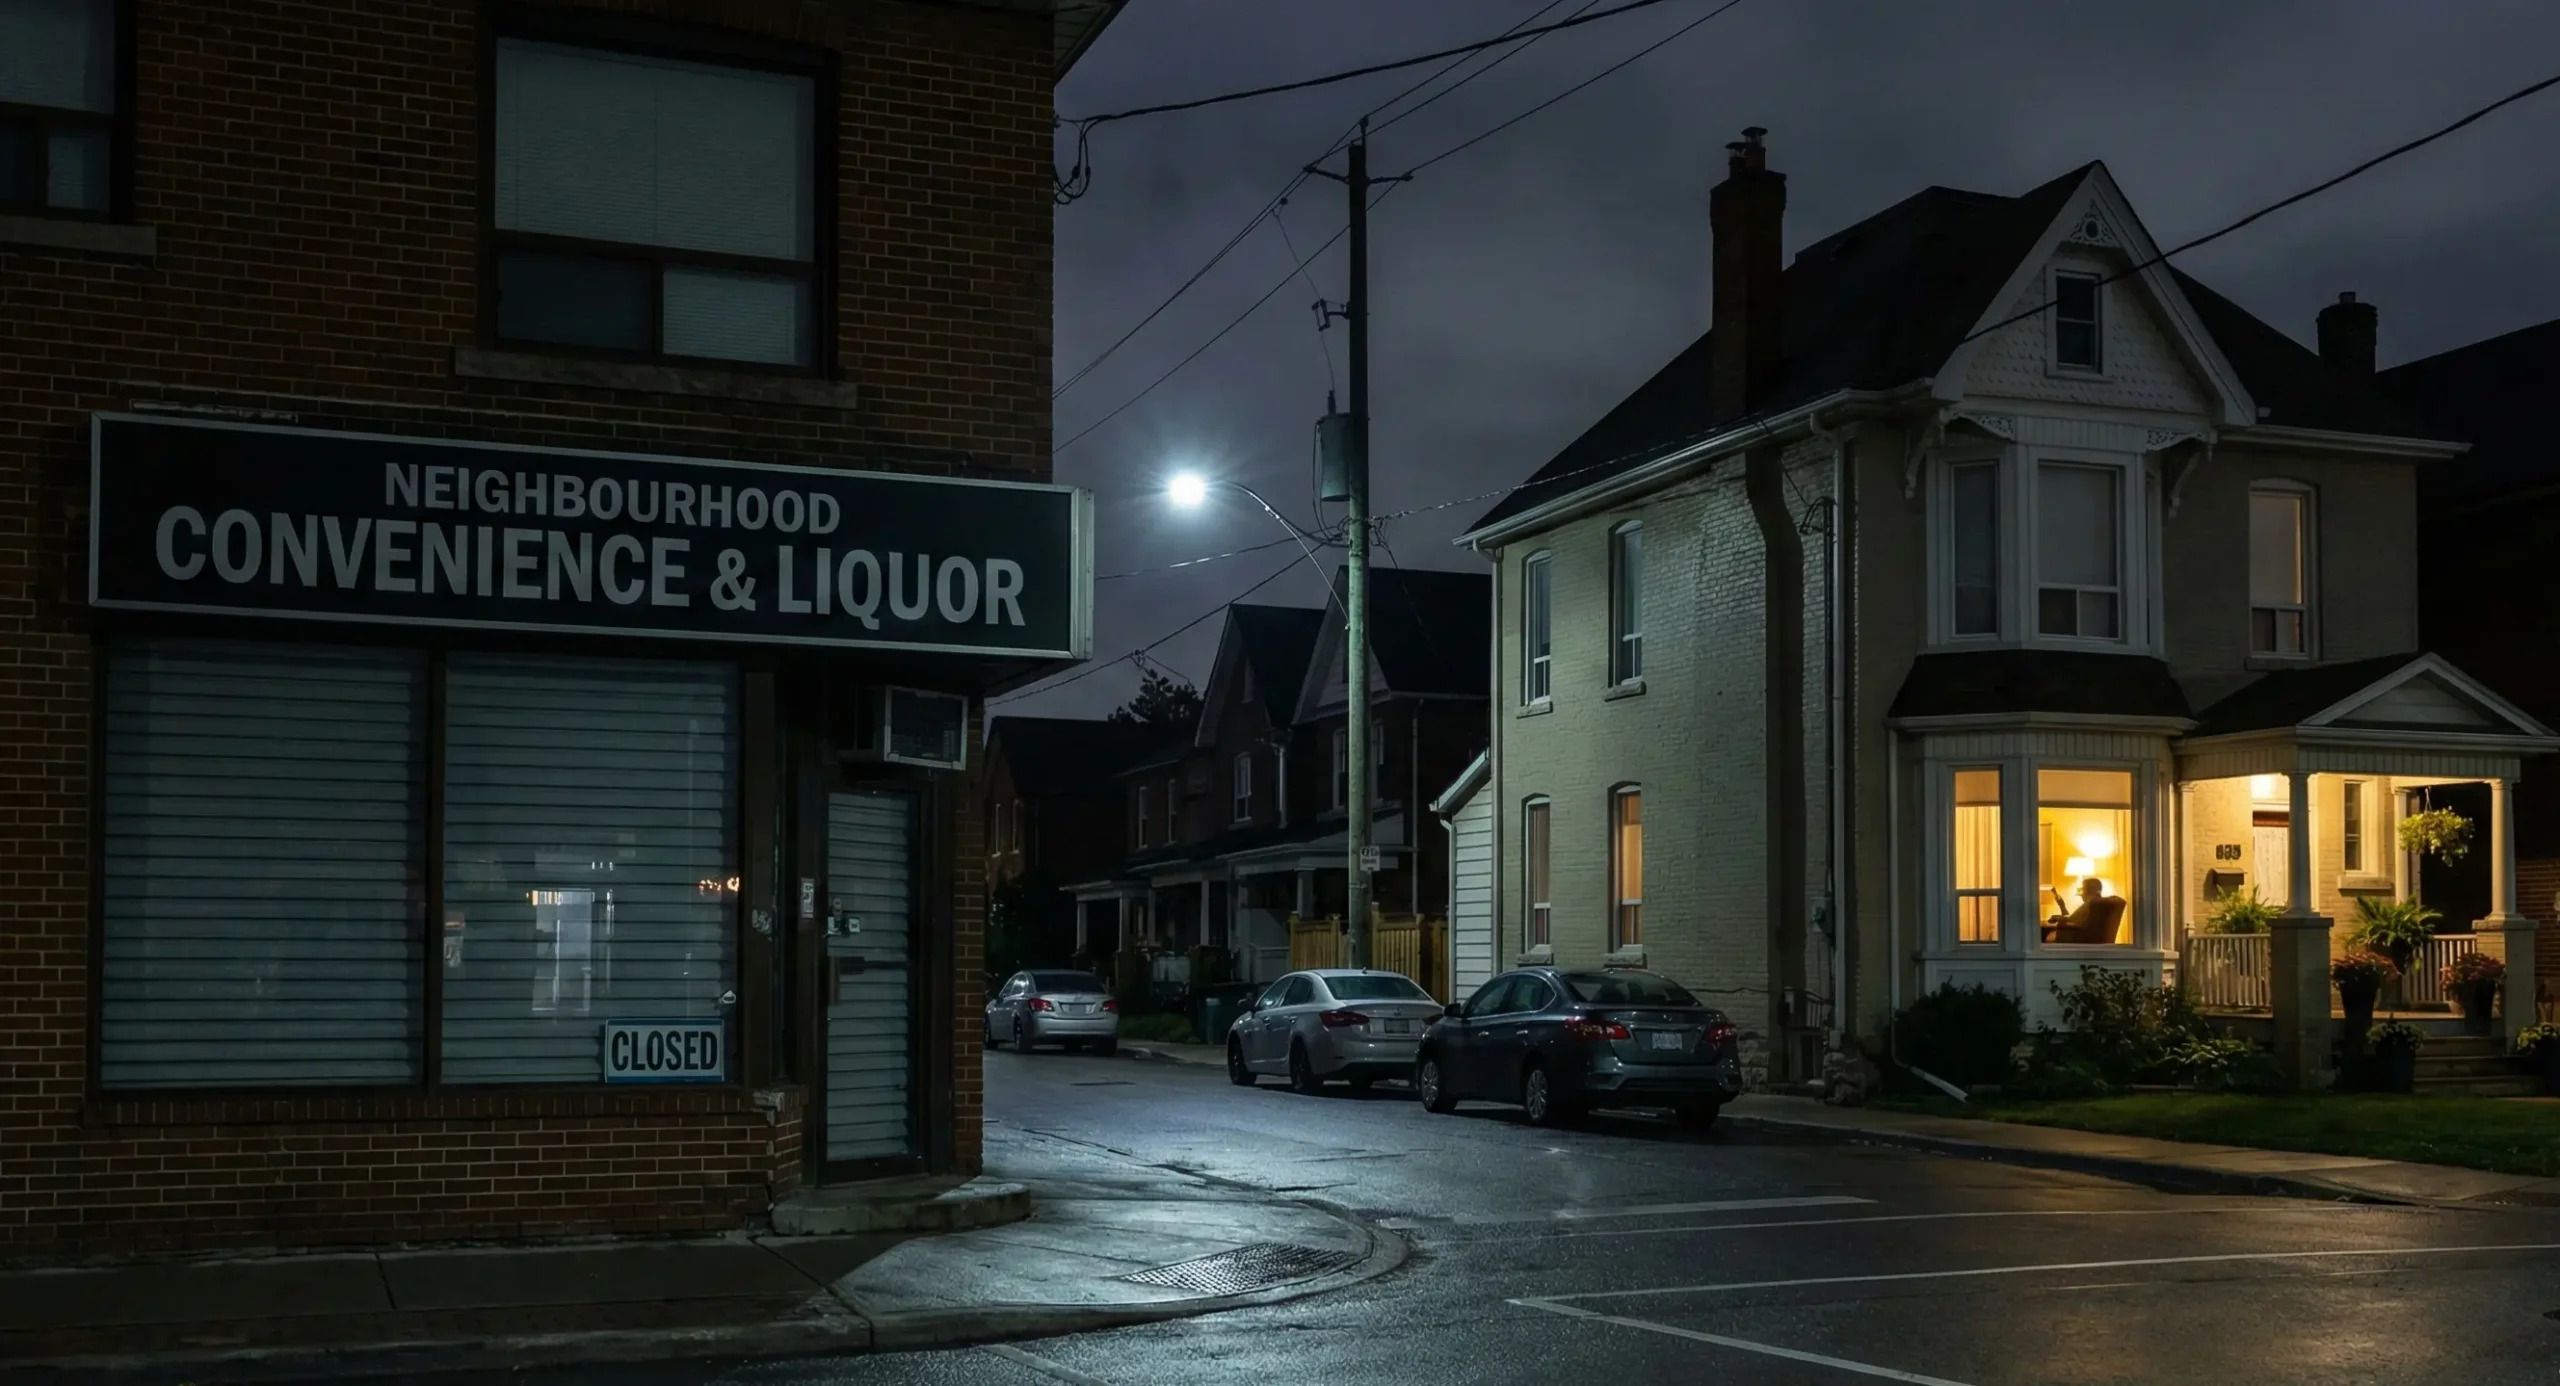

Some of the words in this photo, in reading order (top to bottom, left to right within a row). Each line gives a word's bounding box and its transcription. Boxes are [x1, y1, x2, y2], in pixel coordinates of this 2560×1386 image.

[385, 461, 841, 536] NEIGHBOURHOOD
[155, 504, 691, 608] CONVENIENCE
[709, 547, 757, 612] &
[777, 544, 1026, 631] LIQUOR
[611, 1030, 718, 1071] CLOSED
